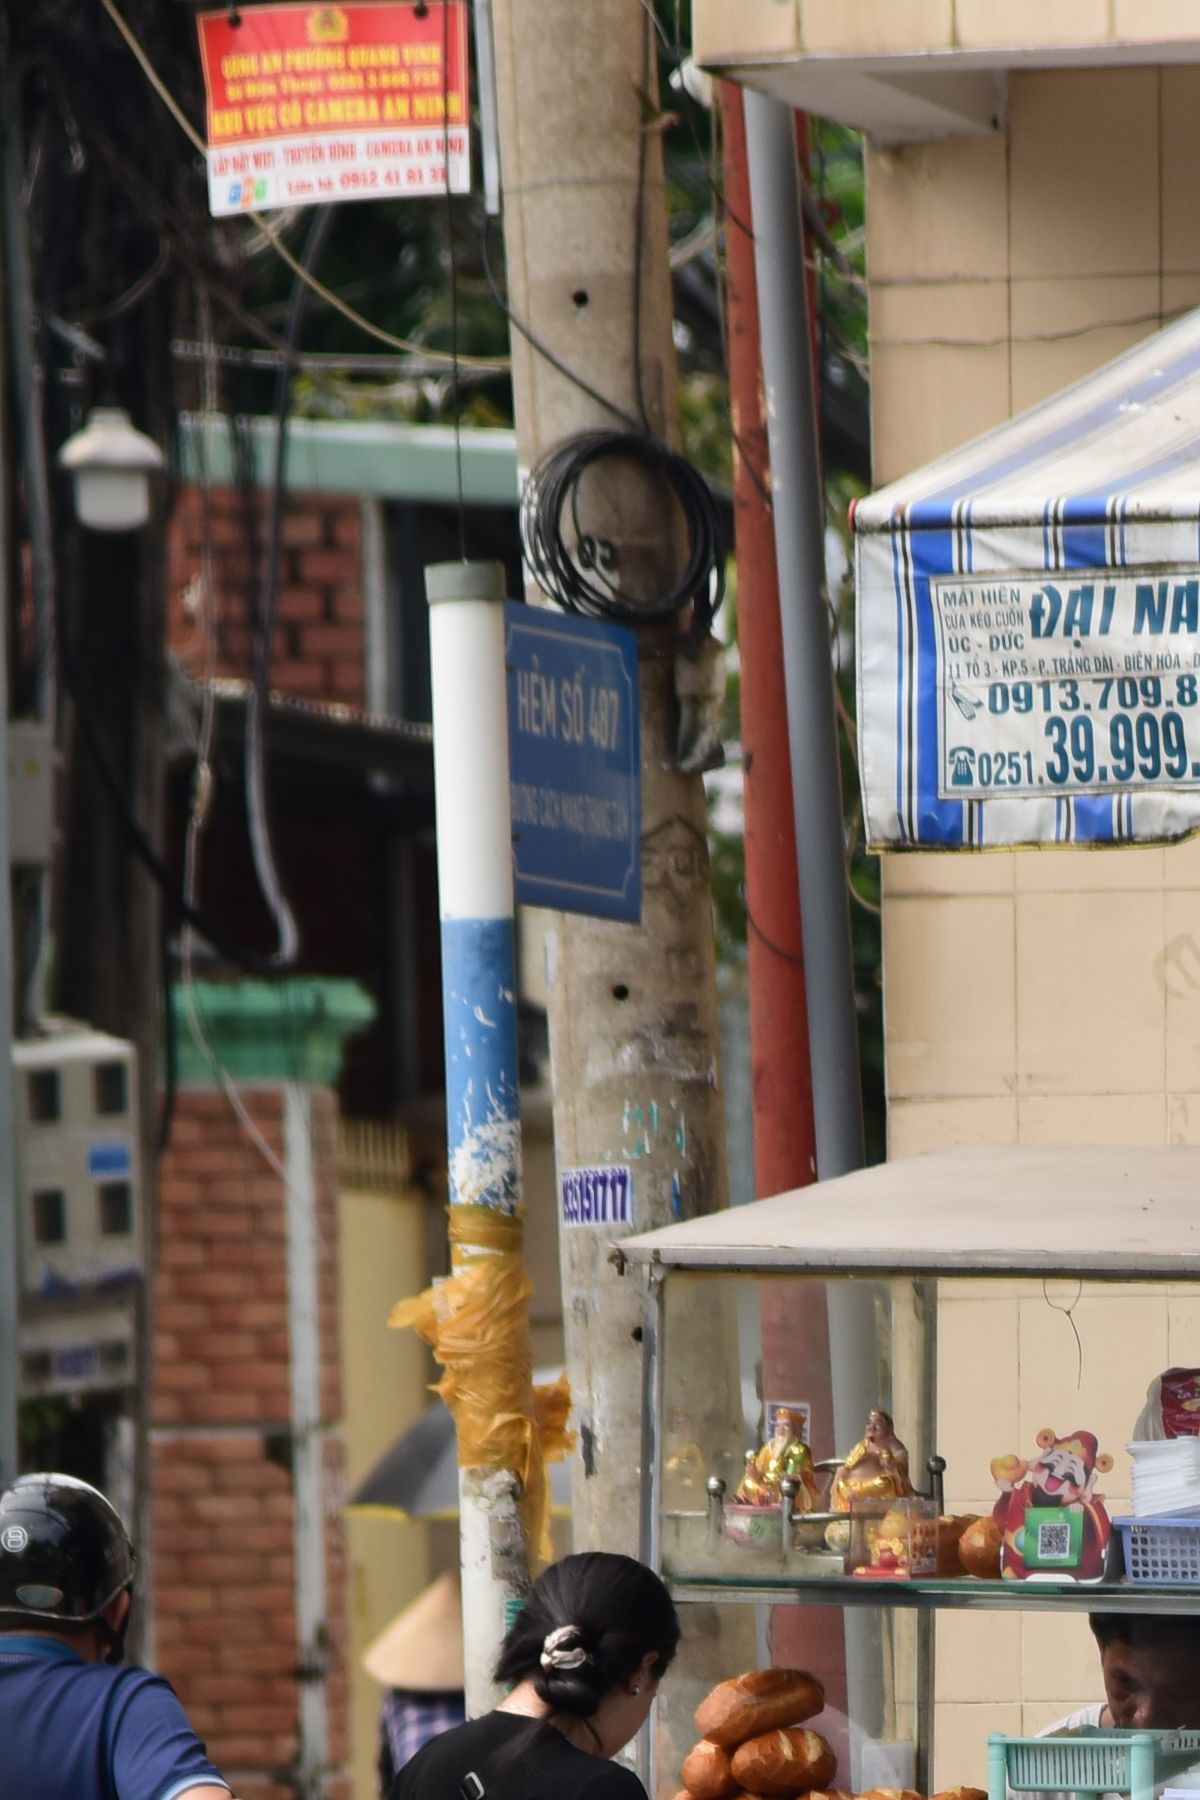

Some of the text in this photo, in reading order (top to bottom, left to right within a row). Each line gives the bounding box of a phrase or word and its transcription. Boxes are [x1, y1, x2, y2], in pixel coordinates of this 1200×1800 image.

[304, 94, 380, 125] CAMERA
[382, 93, 410, 122] AN
[1029, 584, 1116, 649] ĐẠI
[1124, 651, 1152, 671] BIÊN
[561, 664, 584, 745] SỐ
[588, 686, 620, 751] 487
